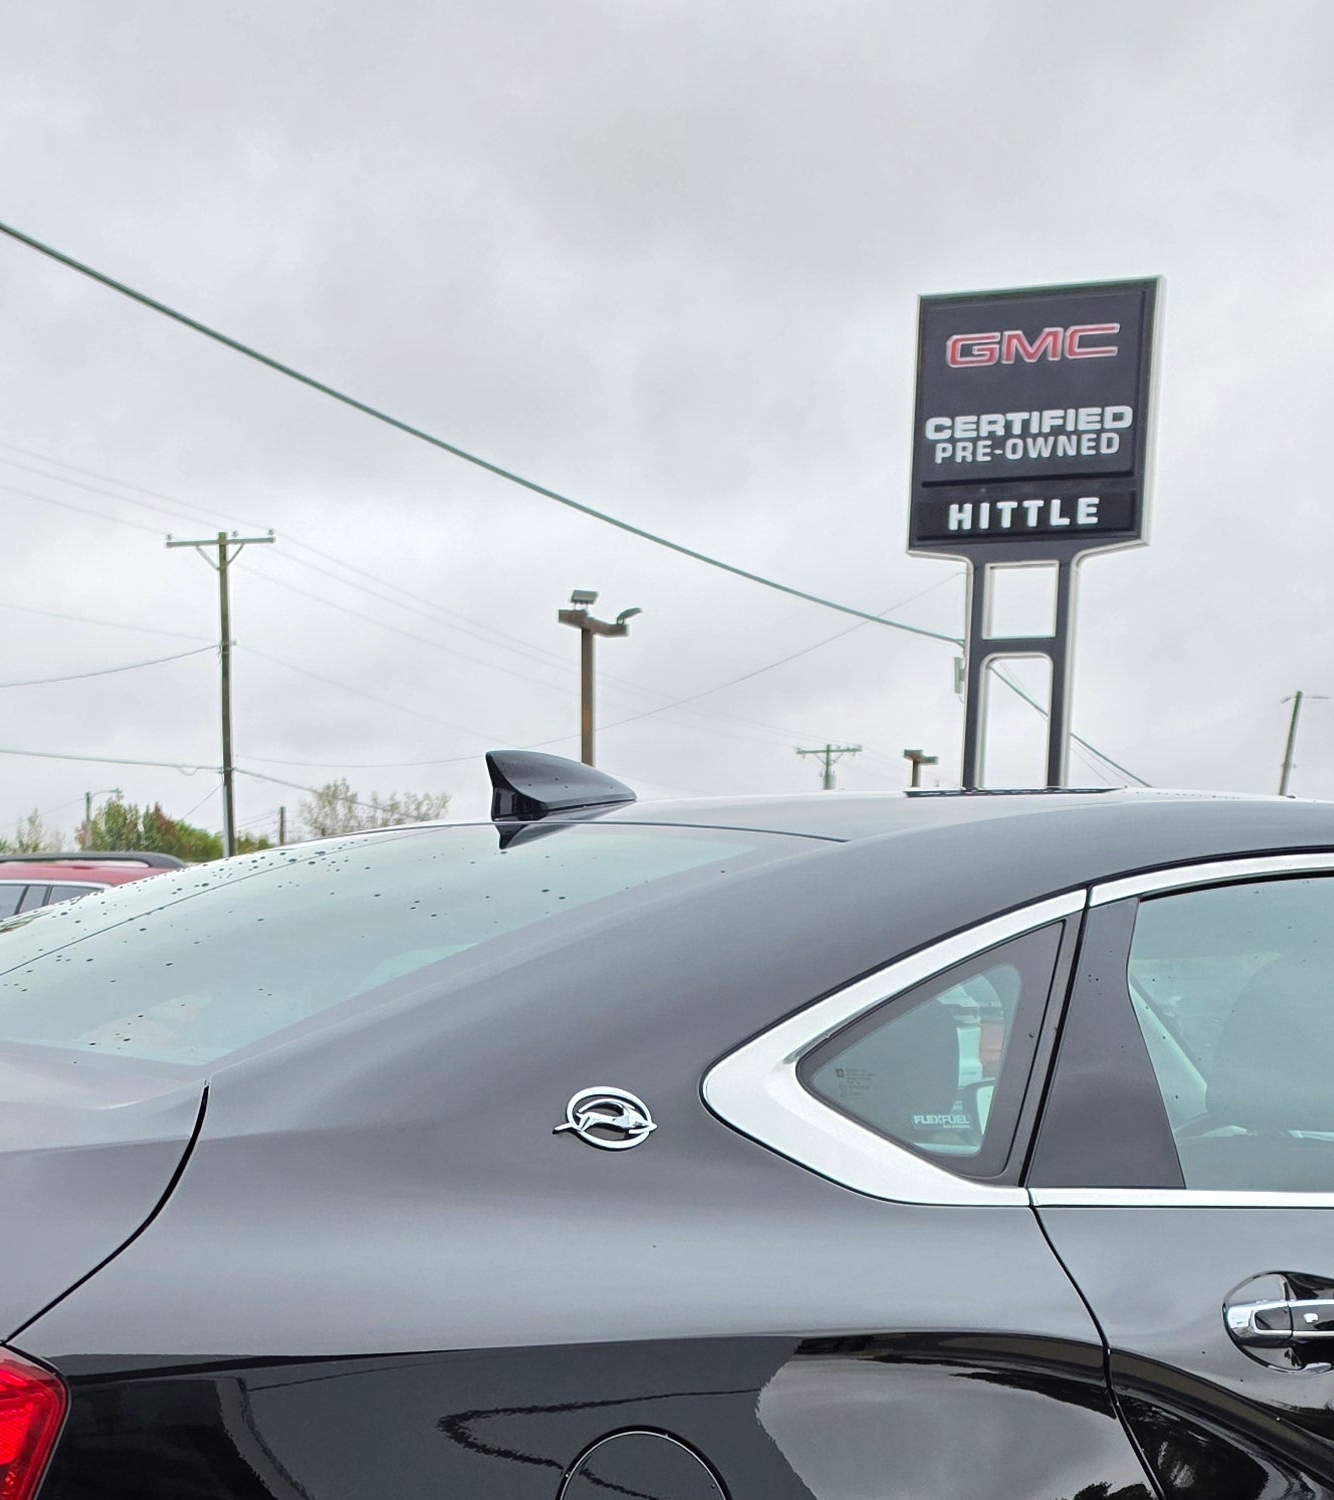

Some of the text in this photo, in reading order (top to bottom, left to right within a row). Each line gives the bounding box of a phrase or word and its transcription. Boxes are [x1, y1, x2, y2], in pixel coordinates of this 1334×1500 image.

[946, 323, 1120, 367] GMC
[925, 405, 1133, 440] CERTIFIED
[934, 432, 1120, 464] PRE-OWNED
[948, 497, 1100, 530] HITTLE
[913, 1114, 970, 1125] FLEXFUEL
